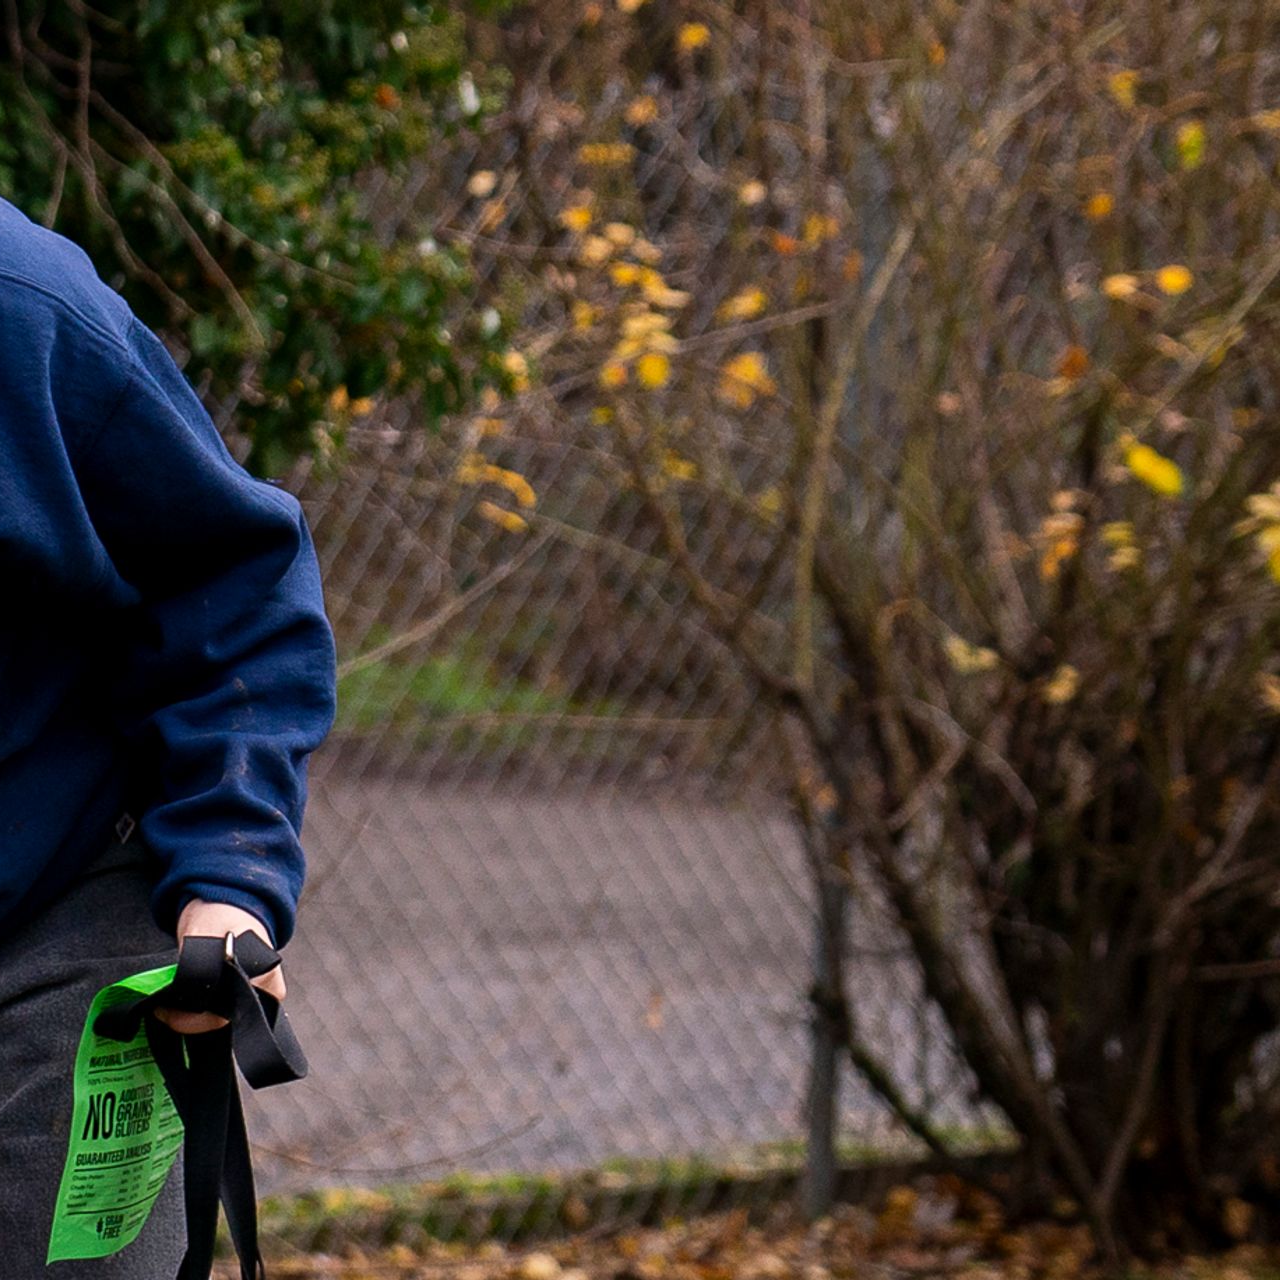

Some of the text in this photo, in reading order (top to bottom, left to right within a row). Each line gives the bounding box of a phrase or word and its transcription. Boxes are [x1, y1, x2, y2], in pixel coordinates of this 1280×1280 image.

[120, 1083, 154, 1102] ADDITIVES
[82, 1091, 116, 1141] NO
[117, 1098, 153, 1122] GRAINS
[76, 1141, 152, 1166] GUARANTEED ANALYSIS
[102, 1226, 121, 1239] FREE
